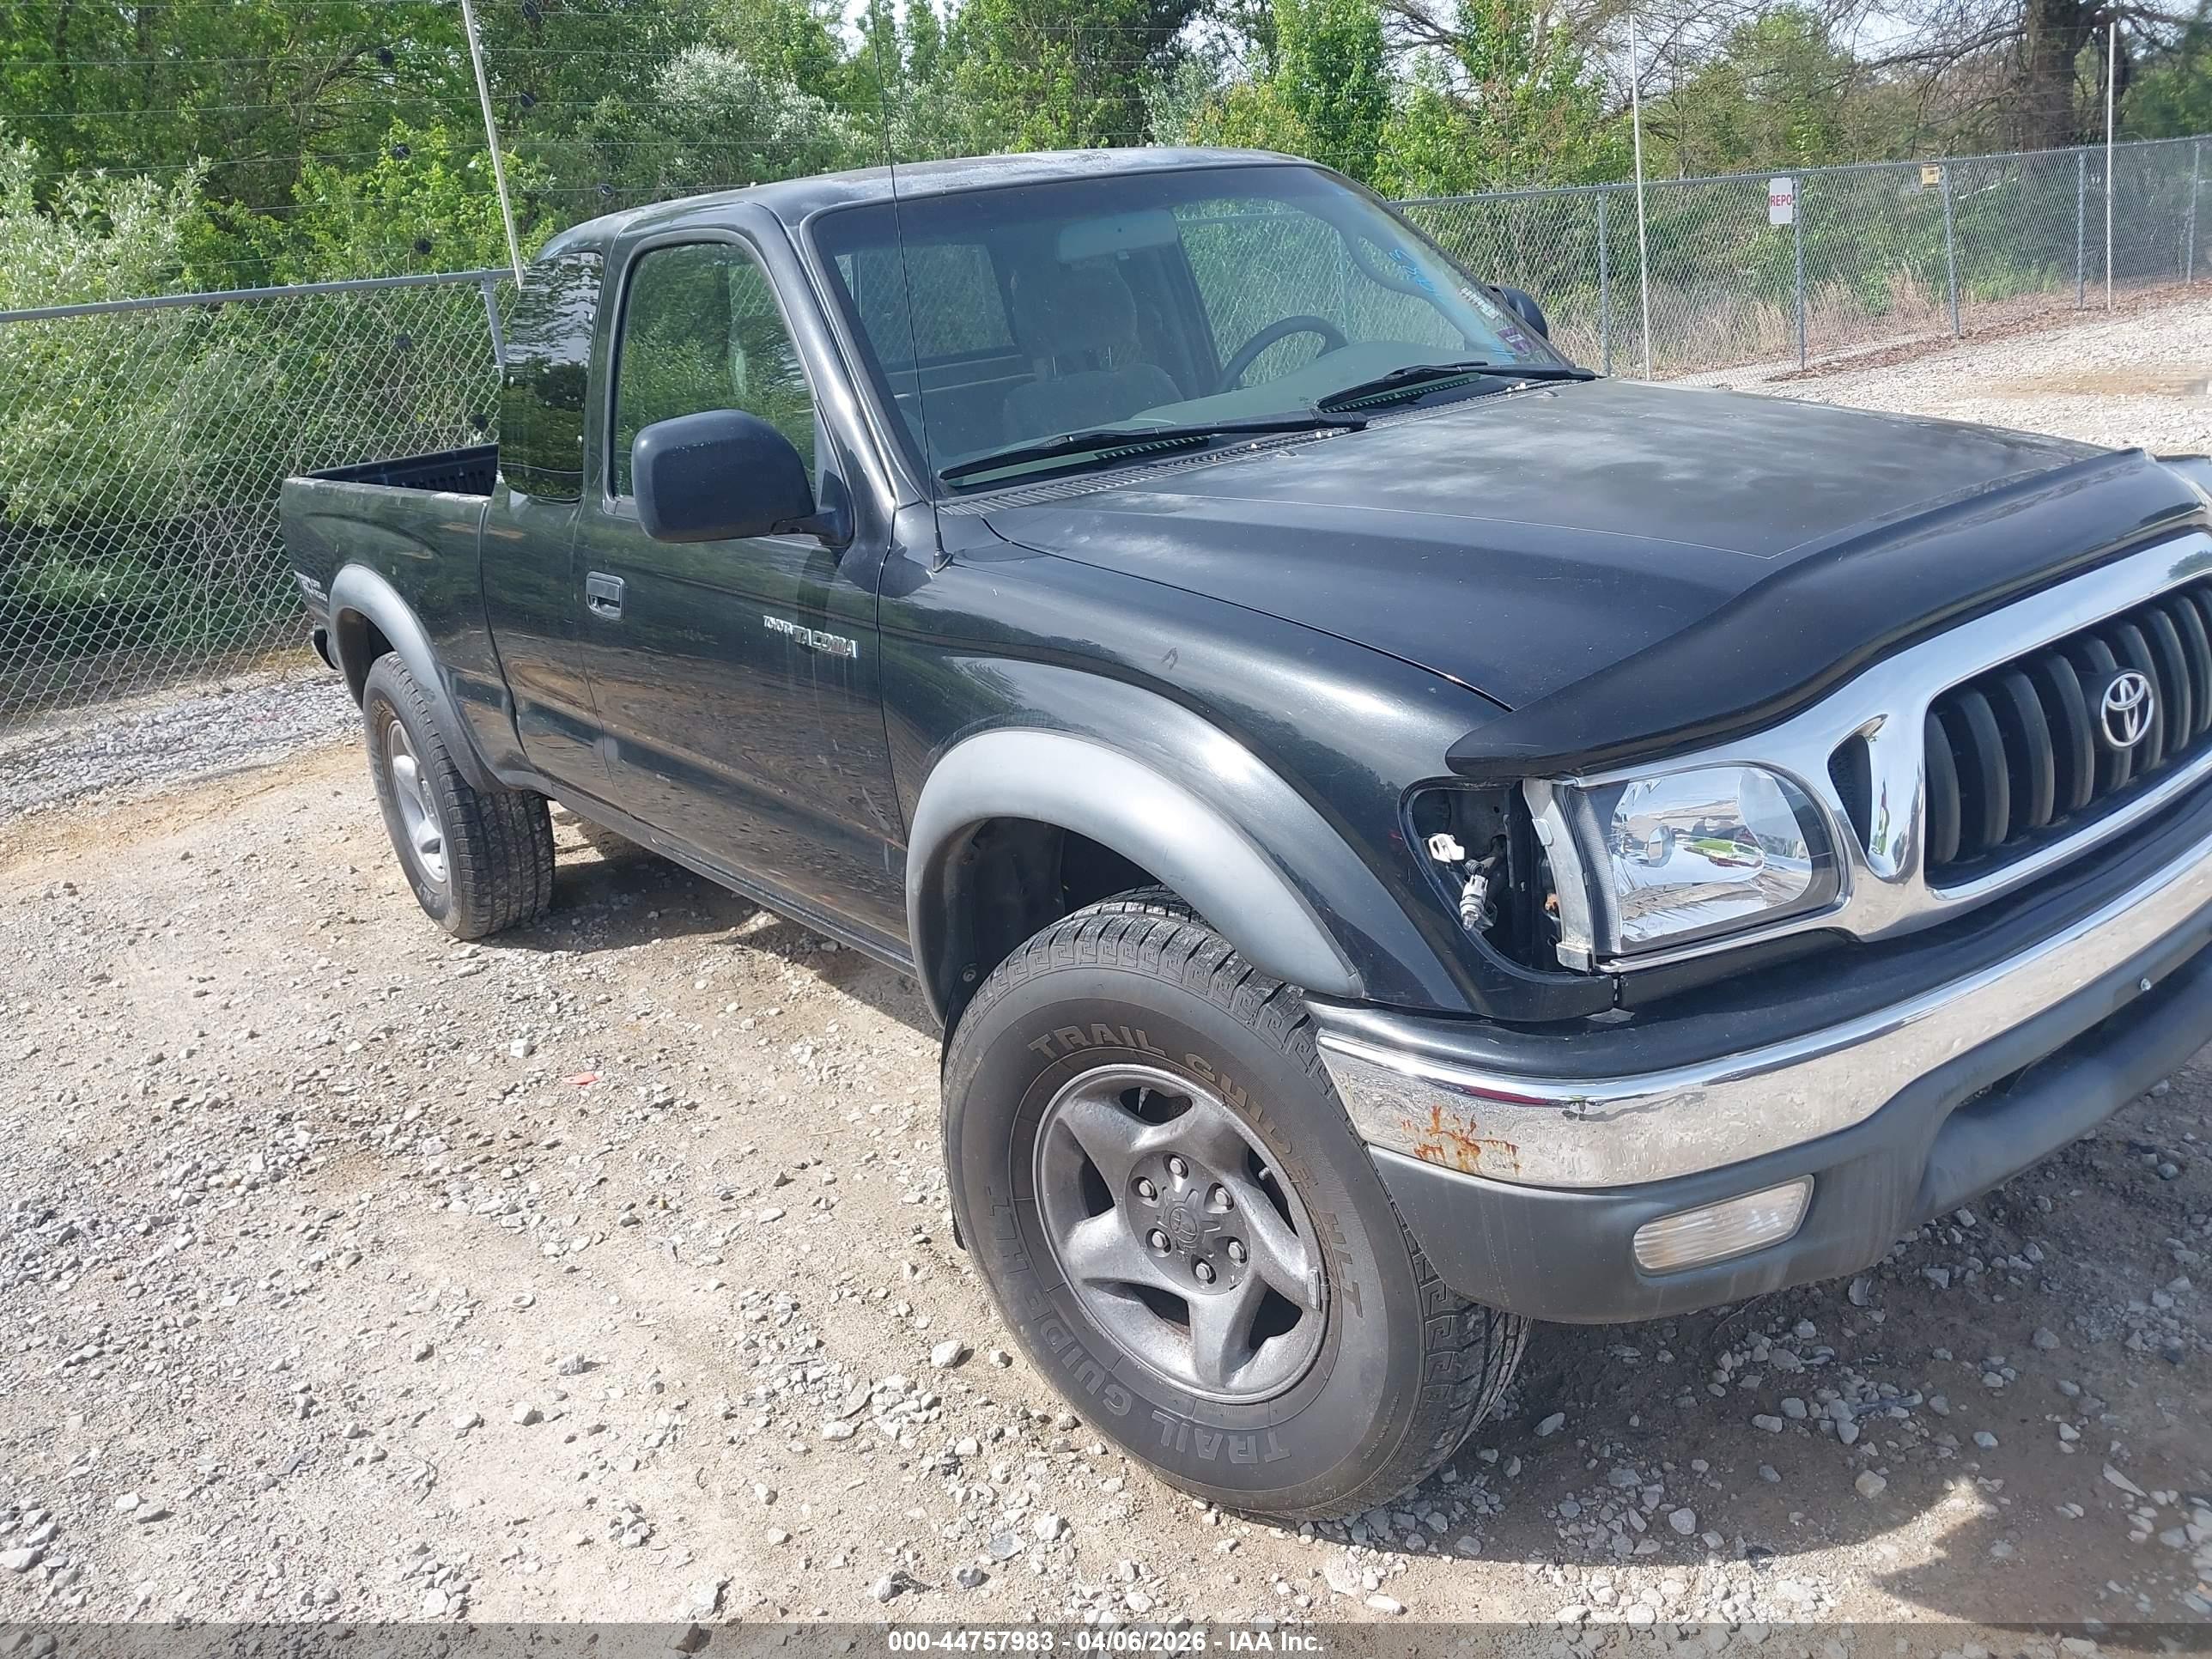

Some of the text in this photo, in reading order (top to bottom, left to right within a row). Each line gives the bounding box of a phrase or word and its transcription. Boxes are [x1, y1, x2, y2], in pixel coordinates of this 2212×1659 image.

[1770, 194, 1792, 207] REPO
[792, 624, 859, 659] TACOMA
[1027, 1023, 1168, 1060] TRAIL
[1152, 1409, 1291, 1464] TRAIL
